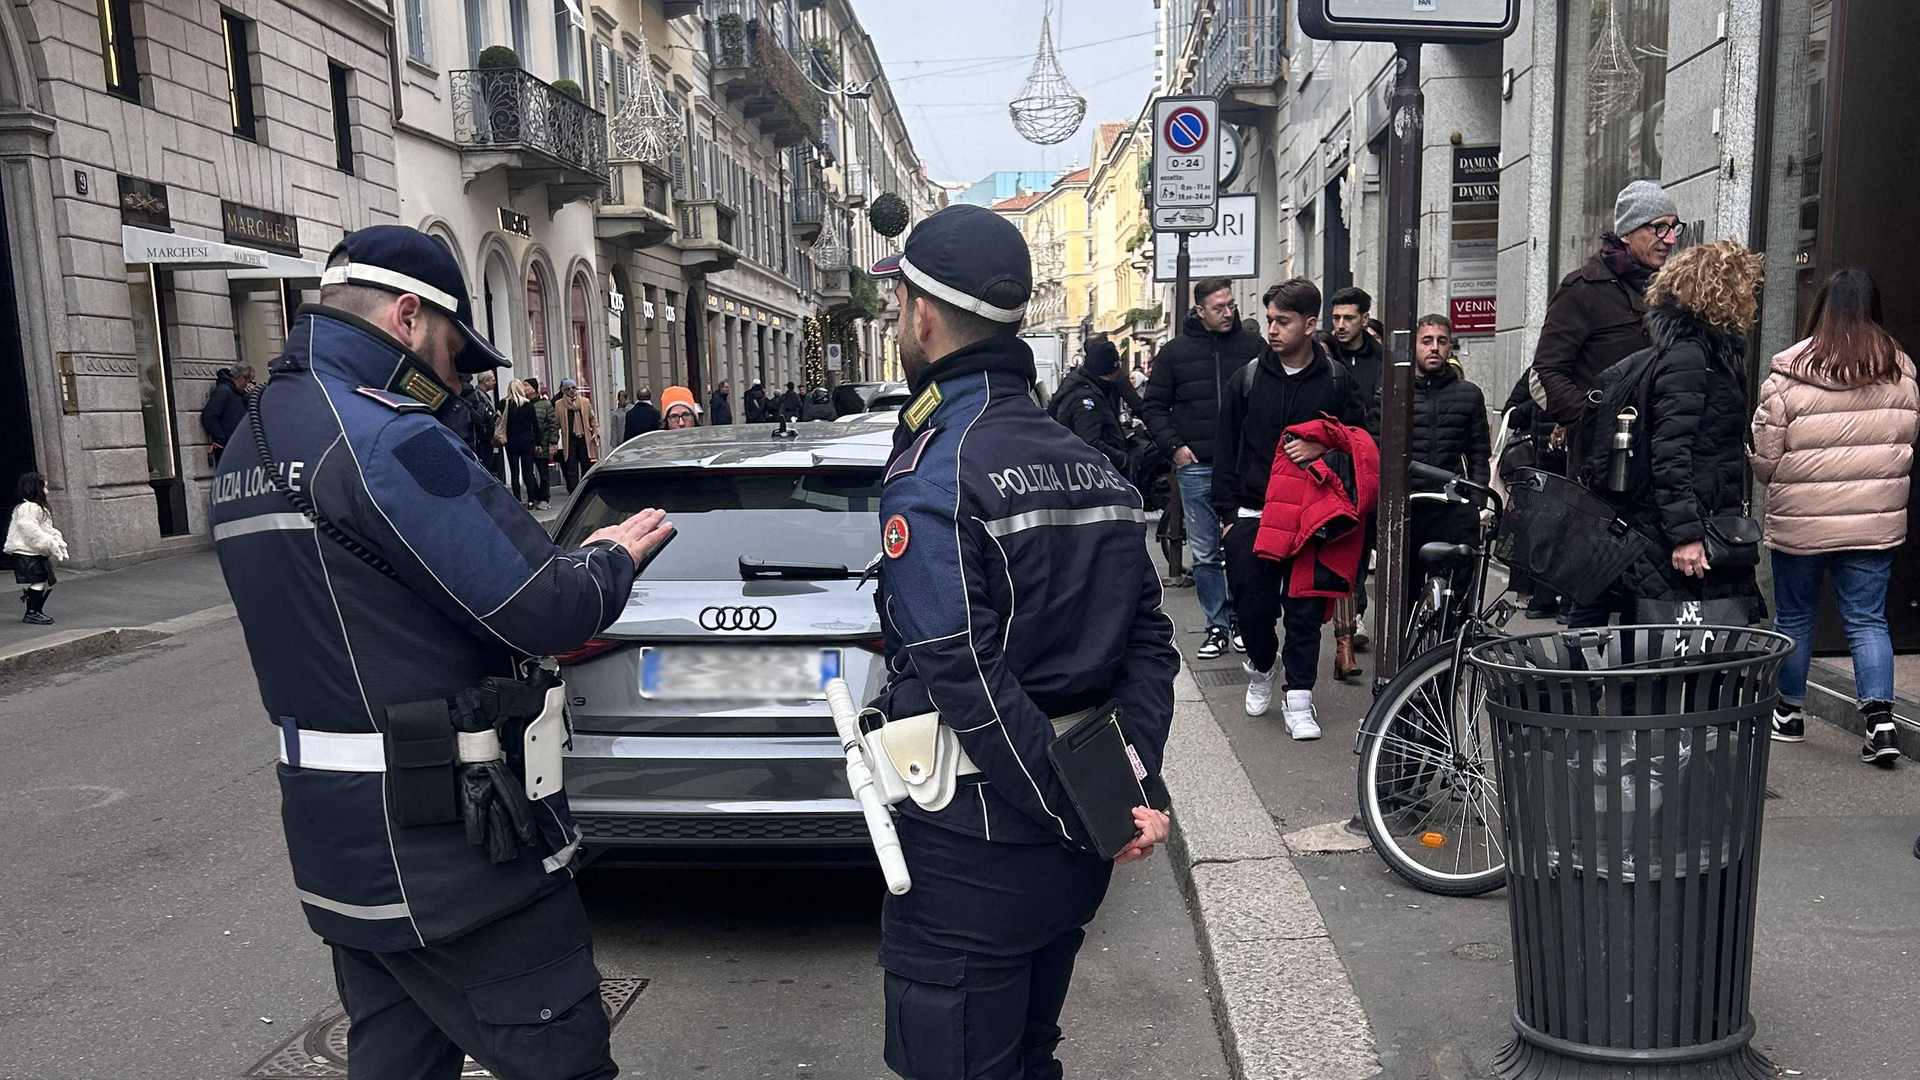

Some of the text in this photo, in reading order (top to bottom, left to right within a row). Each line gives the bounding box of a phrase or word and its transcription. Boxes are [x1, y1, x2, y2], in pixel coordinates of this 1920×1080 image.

[80, 174, 86, 190] 9
[227, 212, 296, 244] MARCHESI
[146, 246, 208, 258] MARCHESI
[1455, 300, 1497, 312] VENIN
[211, 461, 305, 506] OLIZIA LOCE
[987, 462, 1066, 499] POLIZIA
